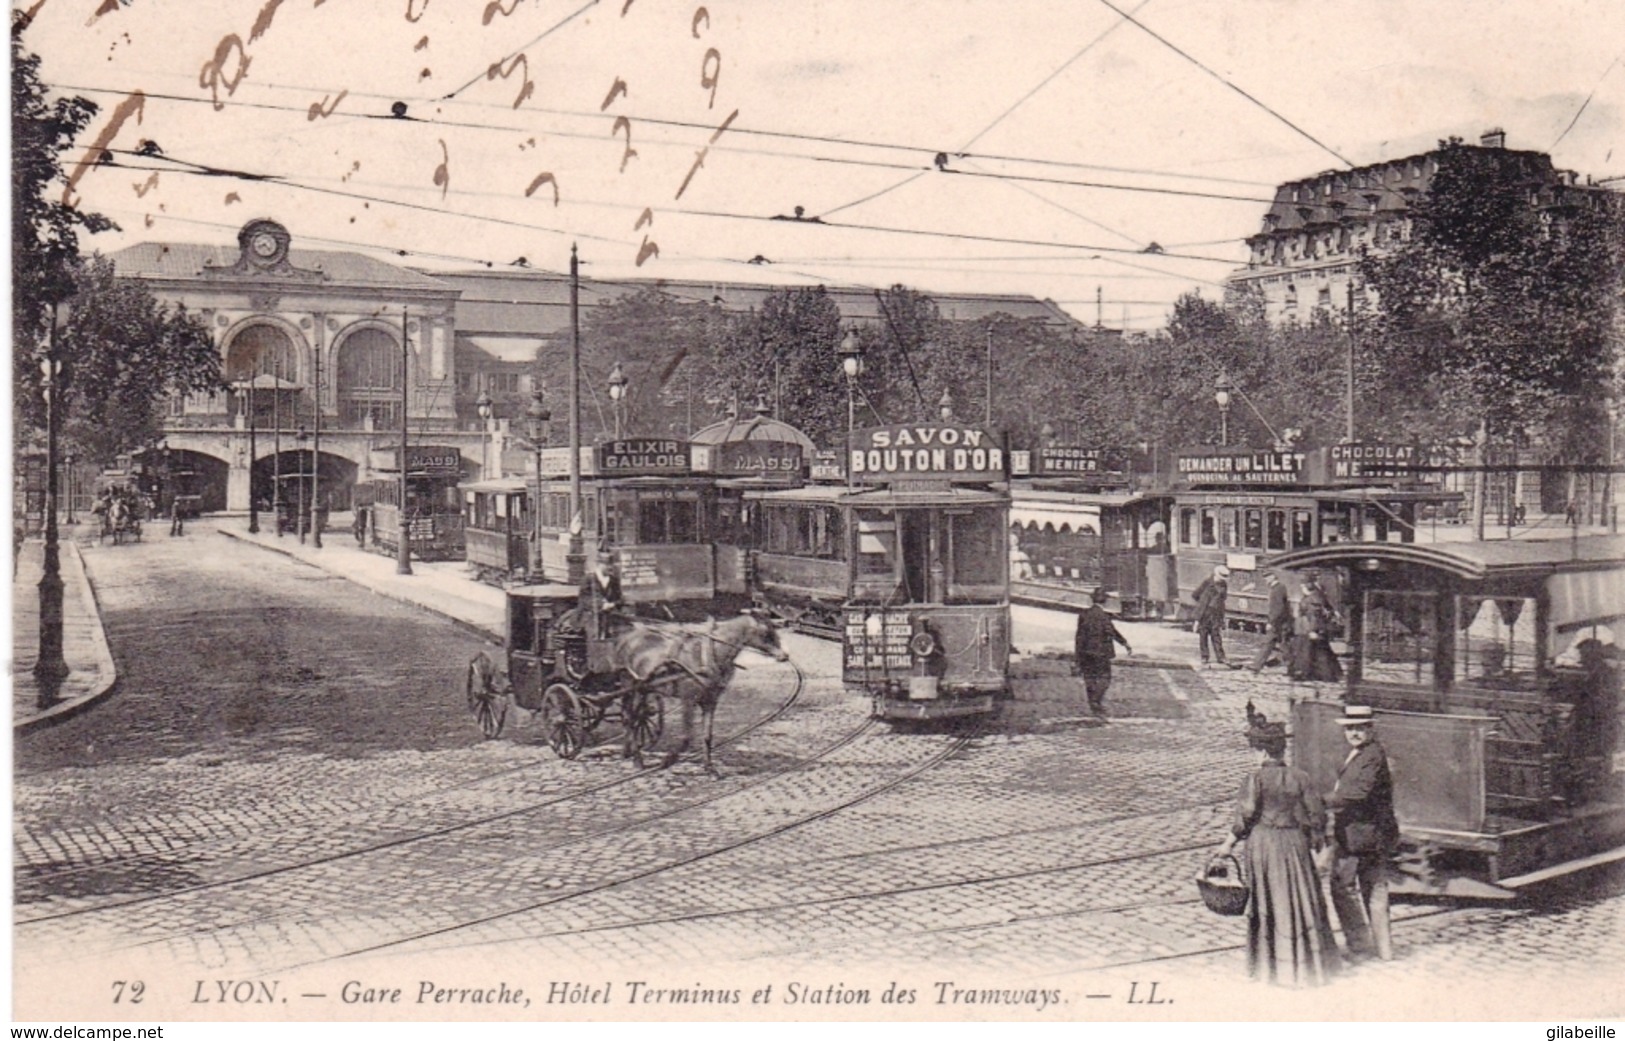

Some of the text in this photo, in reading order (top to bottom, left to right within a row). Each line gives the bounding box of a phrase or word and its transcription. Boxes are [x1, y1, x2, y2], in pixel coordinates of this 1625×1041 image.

[872, 428, 982, 447] SAVON
[614, 442, 678, 454] ELIXIR
[1042, 449, 1100, 458] CHOCOLAT
[1331, 447, 1414, 458] CHOCOLAT
[606, 455, 686, 468] GAULOIS
[852, 449, 946, 472] BOUTON
[954, 448, 1003, 471] D'OR
[1045, 459, 1096, 471] MENIER
[1179, 453, 1305, 471] DEMANDER UN LILET
